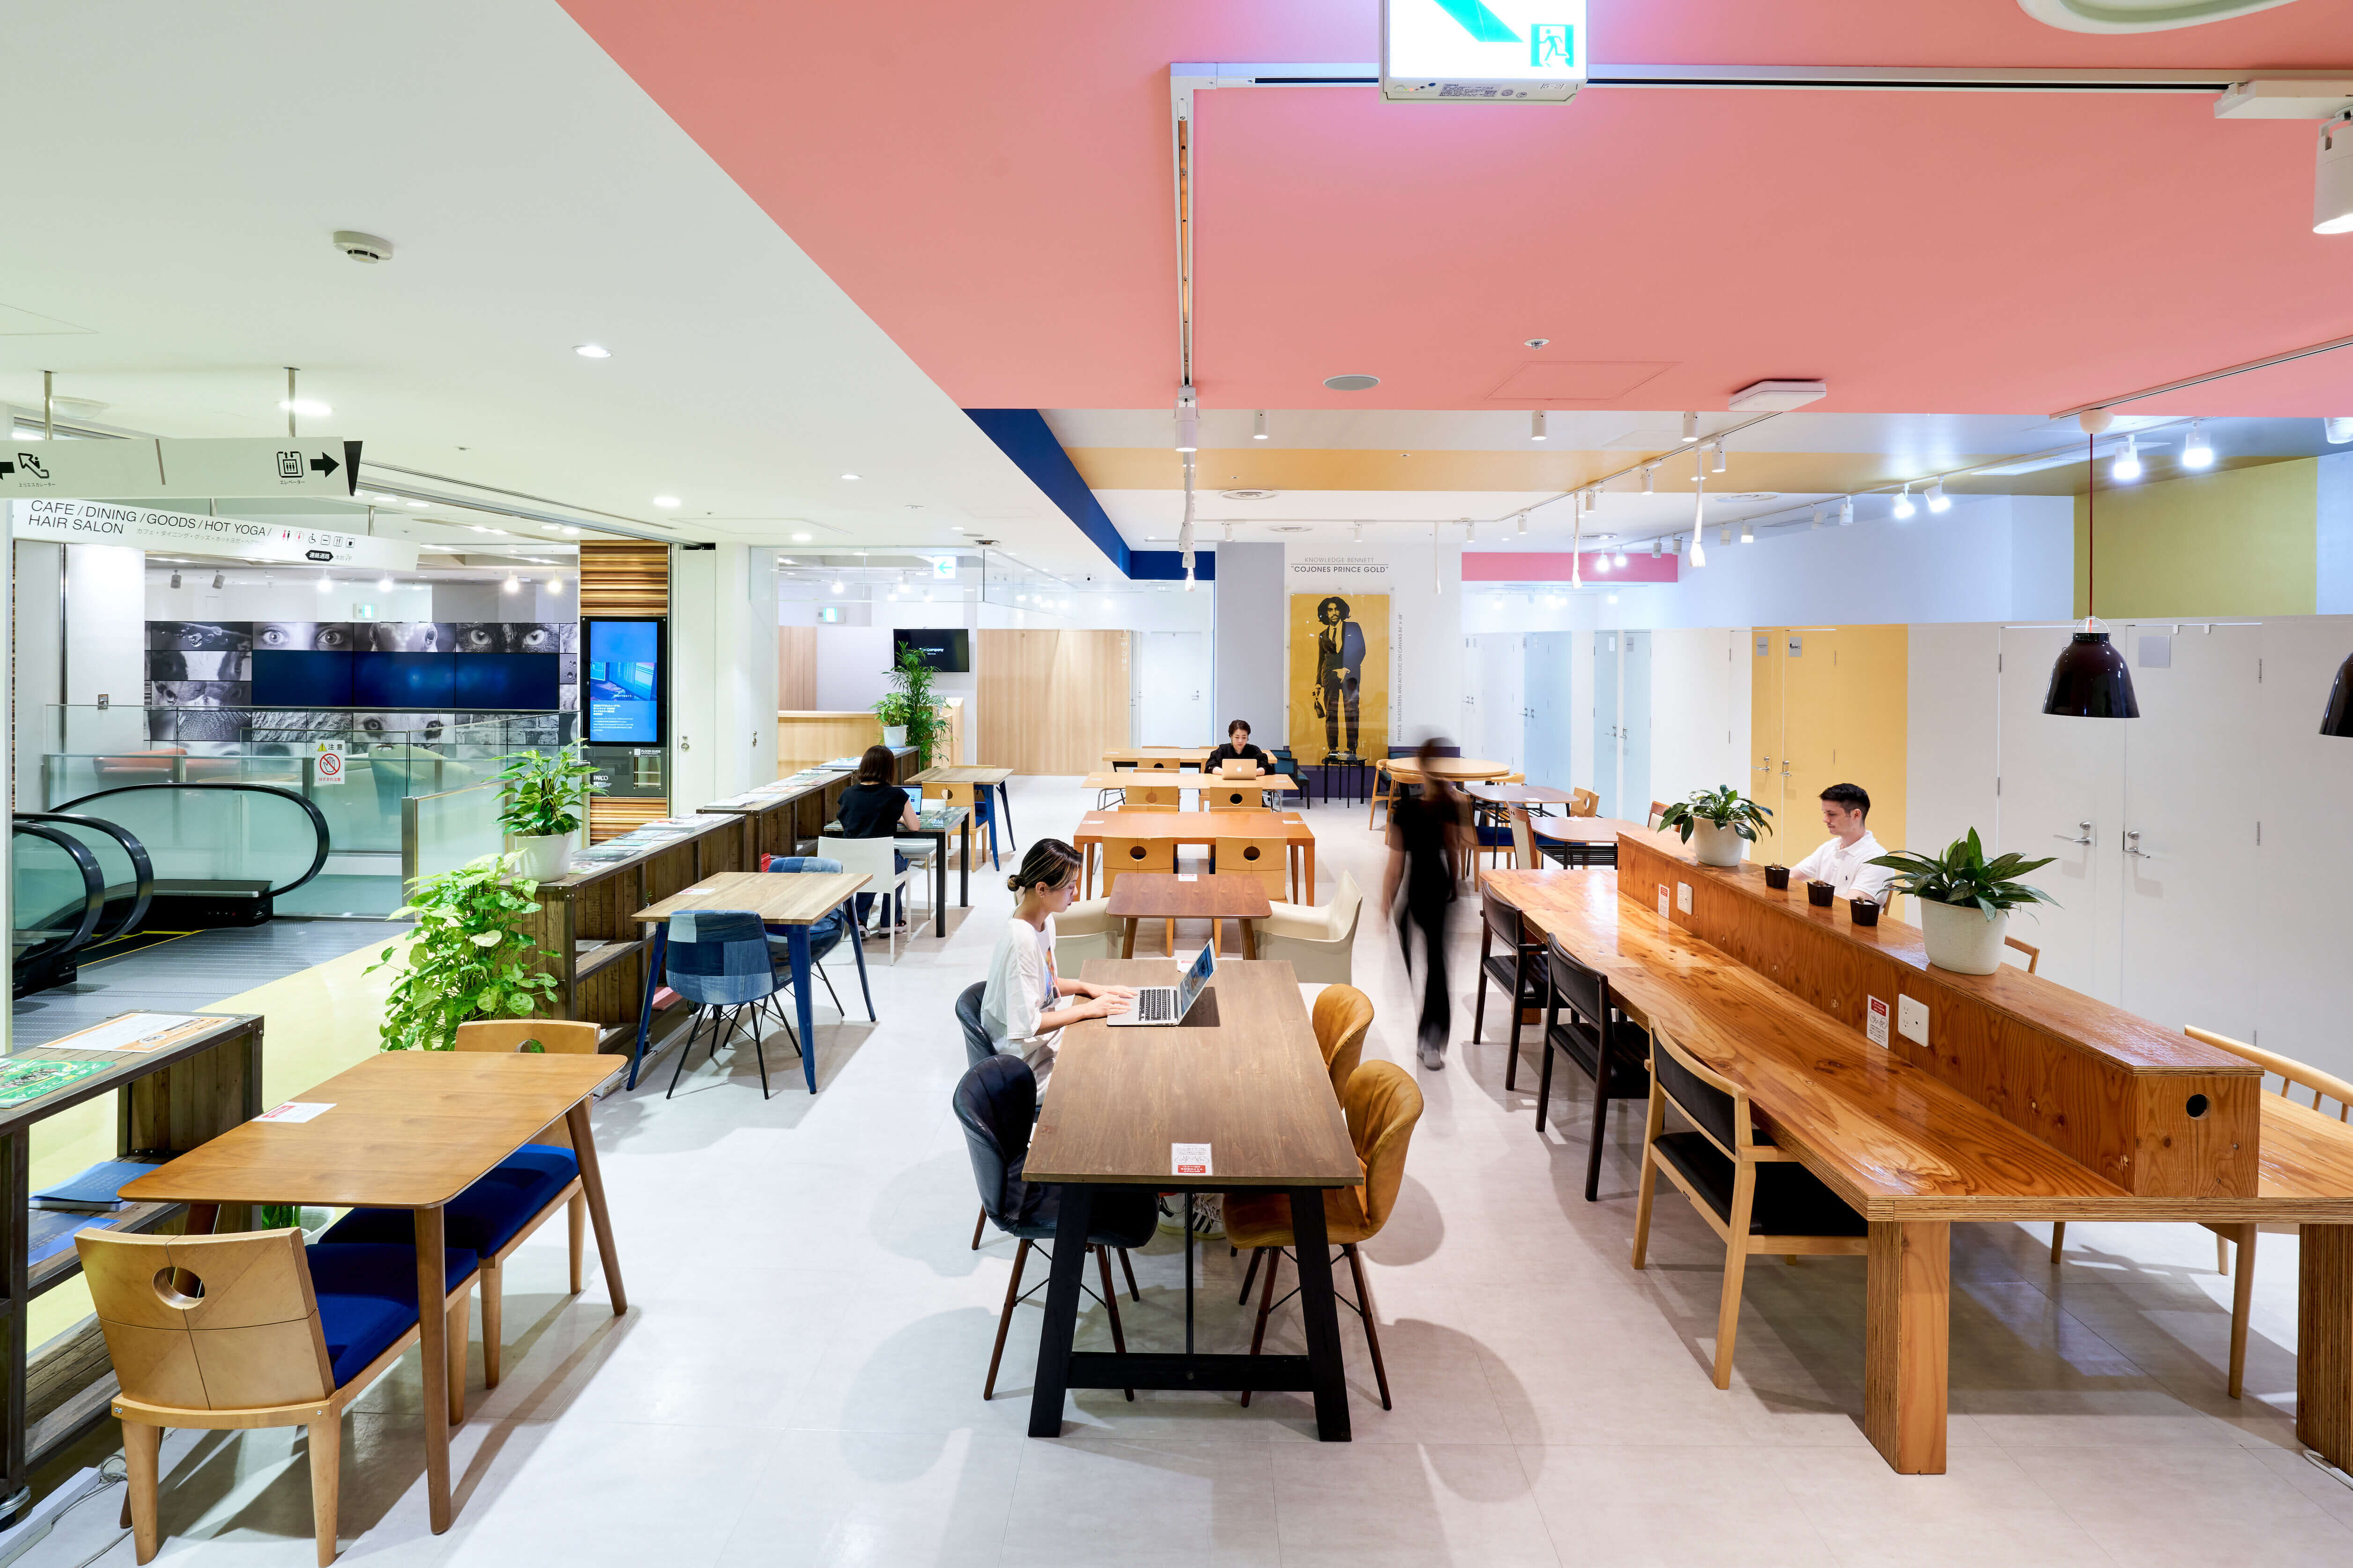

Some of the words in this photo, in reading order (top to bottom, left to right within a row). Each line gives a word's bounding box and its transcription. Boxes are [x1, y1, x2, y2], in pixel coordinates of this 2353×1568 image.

[29, 514, 67, 528] HAIR
[73, 519, 124, 534] SALON
[31, 500, 75, 515] CAFE
[86, 506, 136, 522] DINING
[147, 514, 196, 528] GOODS
[205, 520, 231, 532] HOT
[234, 524, 265, 536] YOGA
